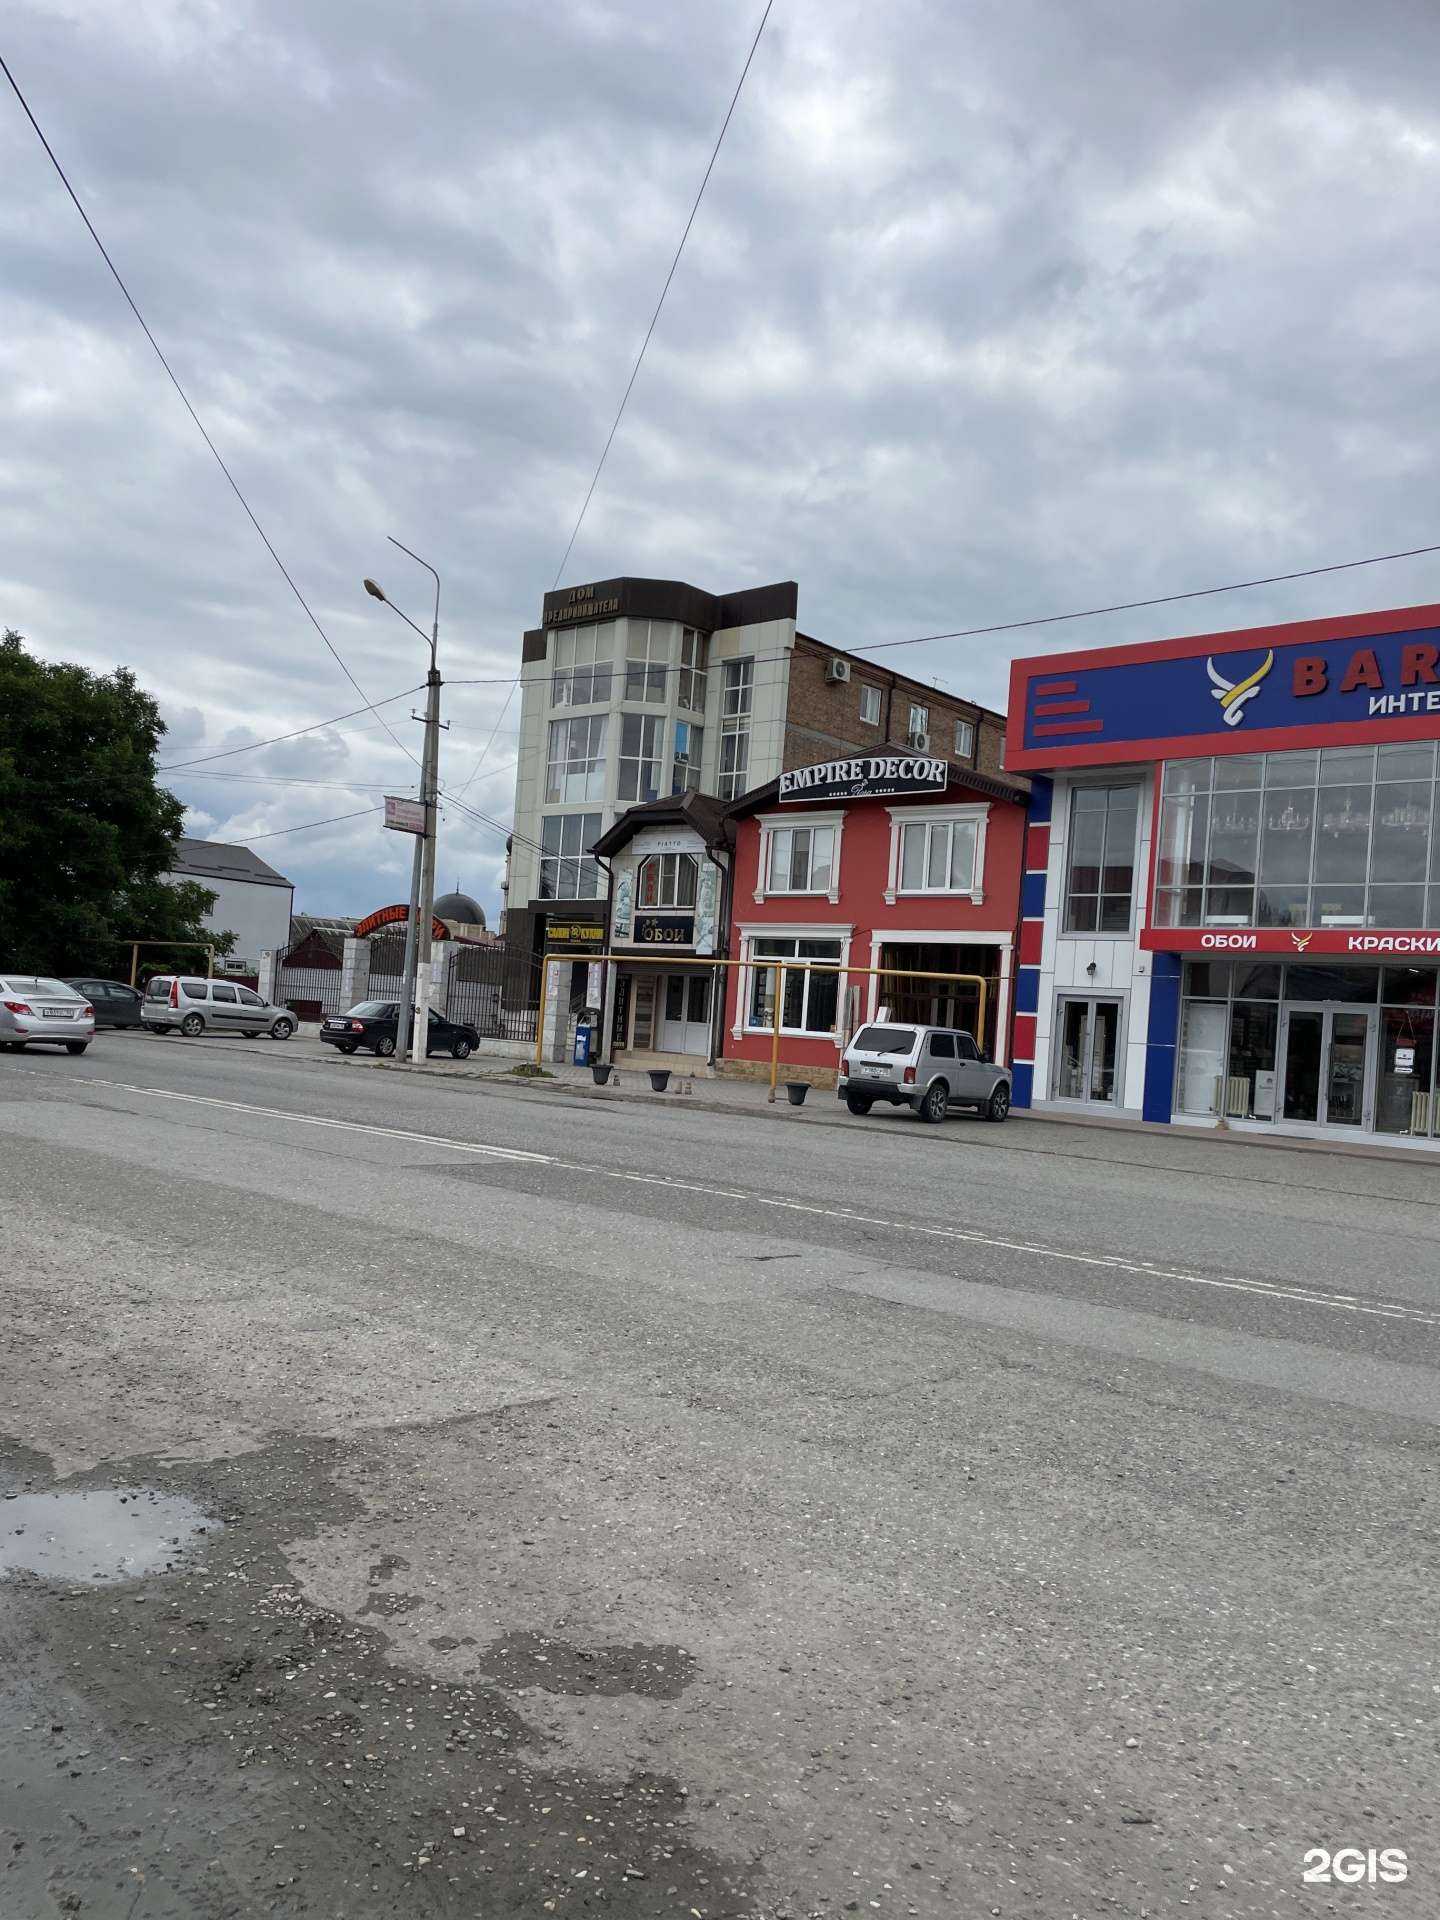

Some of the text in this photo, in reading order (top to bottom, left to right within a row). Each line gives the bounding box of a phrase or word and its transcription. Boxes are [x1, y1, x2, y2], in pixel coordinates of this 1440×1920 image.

[568, 586, 594, 603] ДОМ
[1292, 643, 1440, 697] BAR
[1368, 690, 1440, 716] ИНТЕ
[780, 759, 864, 794] EMPIRE
[868, 758, 946, 783] DECOR
[643, 927, 685, 942] ОБОИ
[1200, 933, 1257, 949] ОБОИ
[1348, 935, 1440, 952] КРАСКИ
